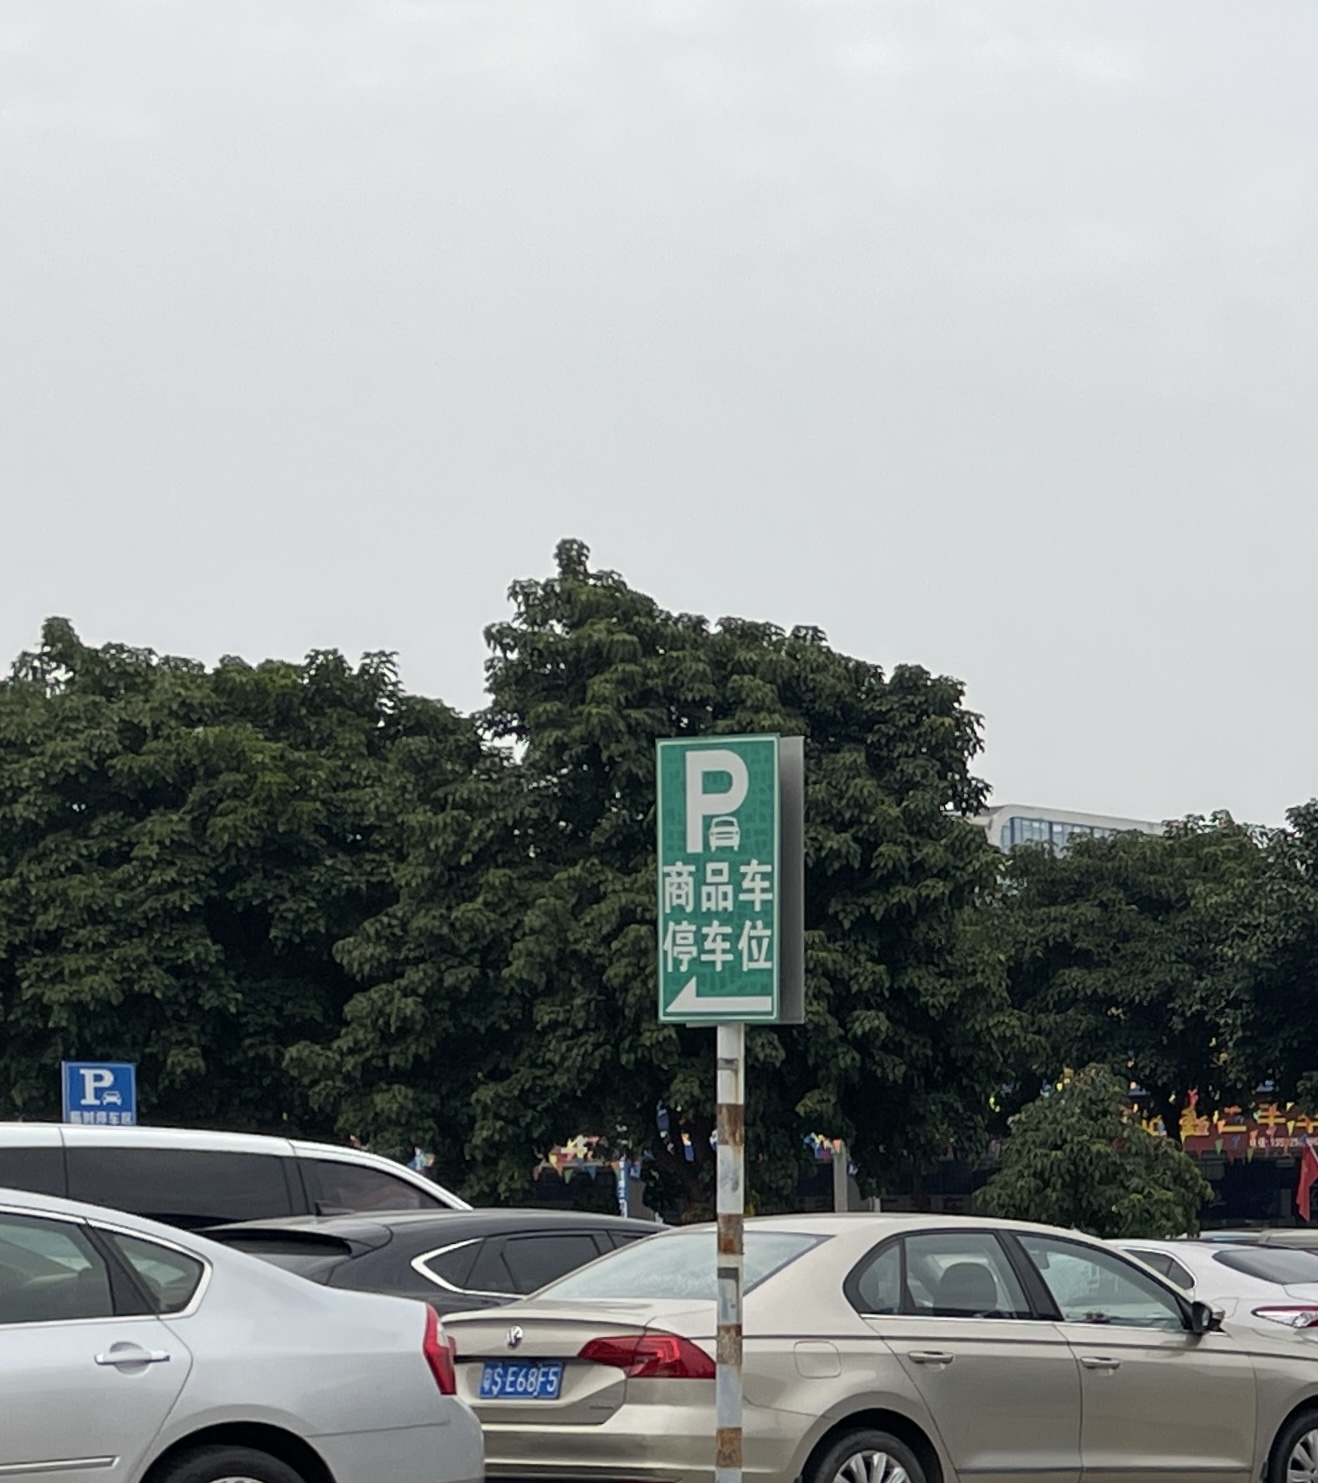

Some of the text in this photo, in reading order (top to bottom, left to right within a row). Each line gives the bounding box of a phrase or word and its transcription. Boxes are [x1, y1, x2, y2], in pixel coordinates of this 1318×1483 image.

[686, 750, 749, 853] P
[662, 859, 773, 913] 商品车
[663, 920, 773, 973] 停车位
[80, 1069, 114, 1105] P
